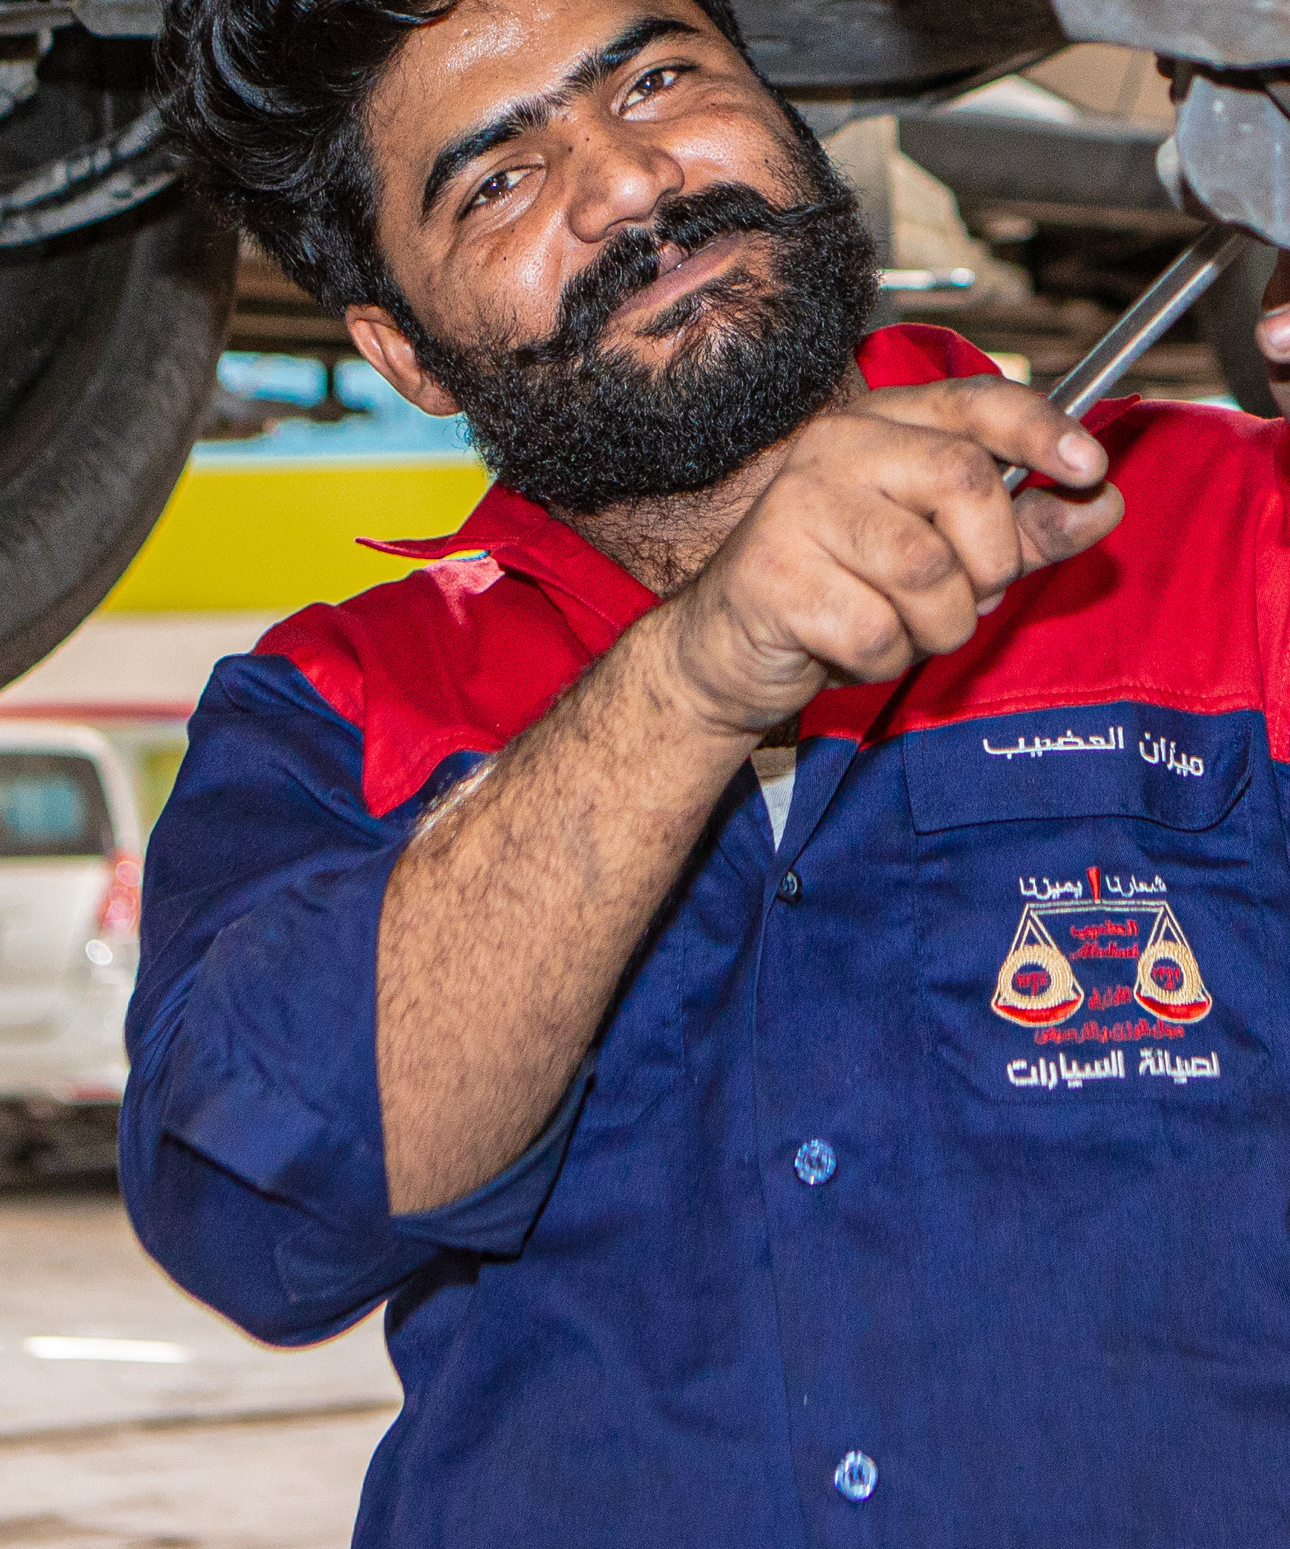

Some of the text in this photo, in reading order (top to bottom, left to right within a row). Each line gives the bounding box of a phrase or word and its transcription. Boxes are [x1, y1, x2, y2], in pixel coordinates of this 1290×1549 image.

[982, 726, 1205, 777] ميزان العضيب
[1105, 874, 1168, 898] شعارنا
[1006, 1047, 1221, 1091] لصيانة السيارات
